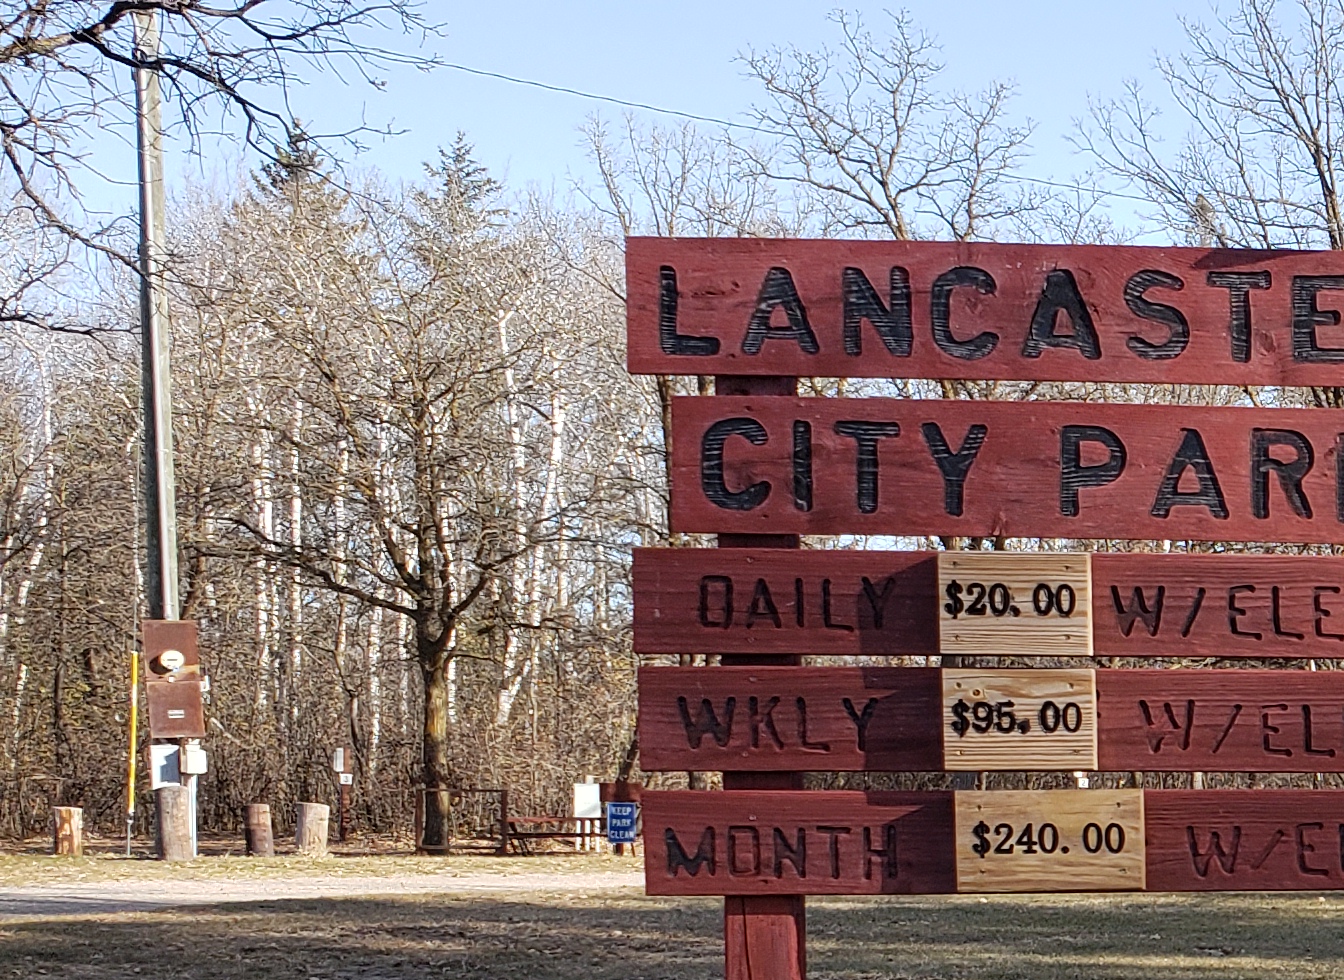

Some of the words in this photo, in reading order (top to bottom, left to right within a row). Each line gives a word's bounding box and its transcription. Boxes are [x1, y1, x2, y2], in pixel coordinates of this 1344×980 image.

[702, 417, 989, 517] CITY
[697, 576, 898, 632] DAILY
[945, 580, 1078, 620] $20.00
[676, 694, 880, 752] WKLY
[949, 699, 1083, 737] $95.00
[610, 830, 635, 840] CLEAN
[611, 818, 632, 827] PARK
[664, 824, 898, 878] MONTH
[971, 820, 1126, 857] $240.00
